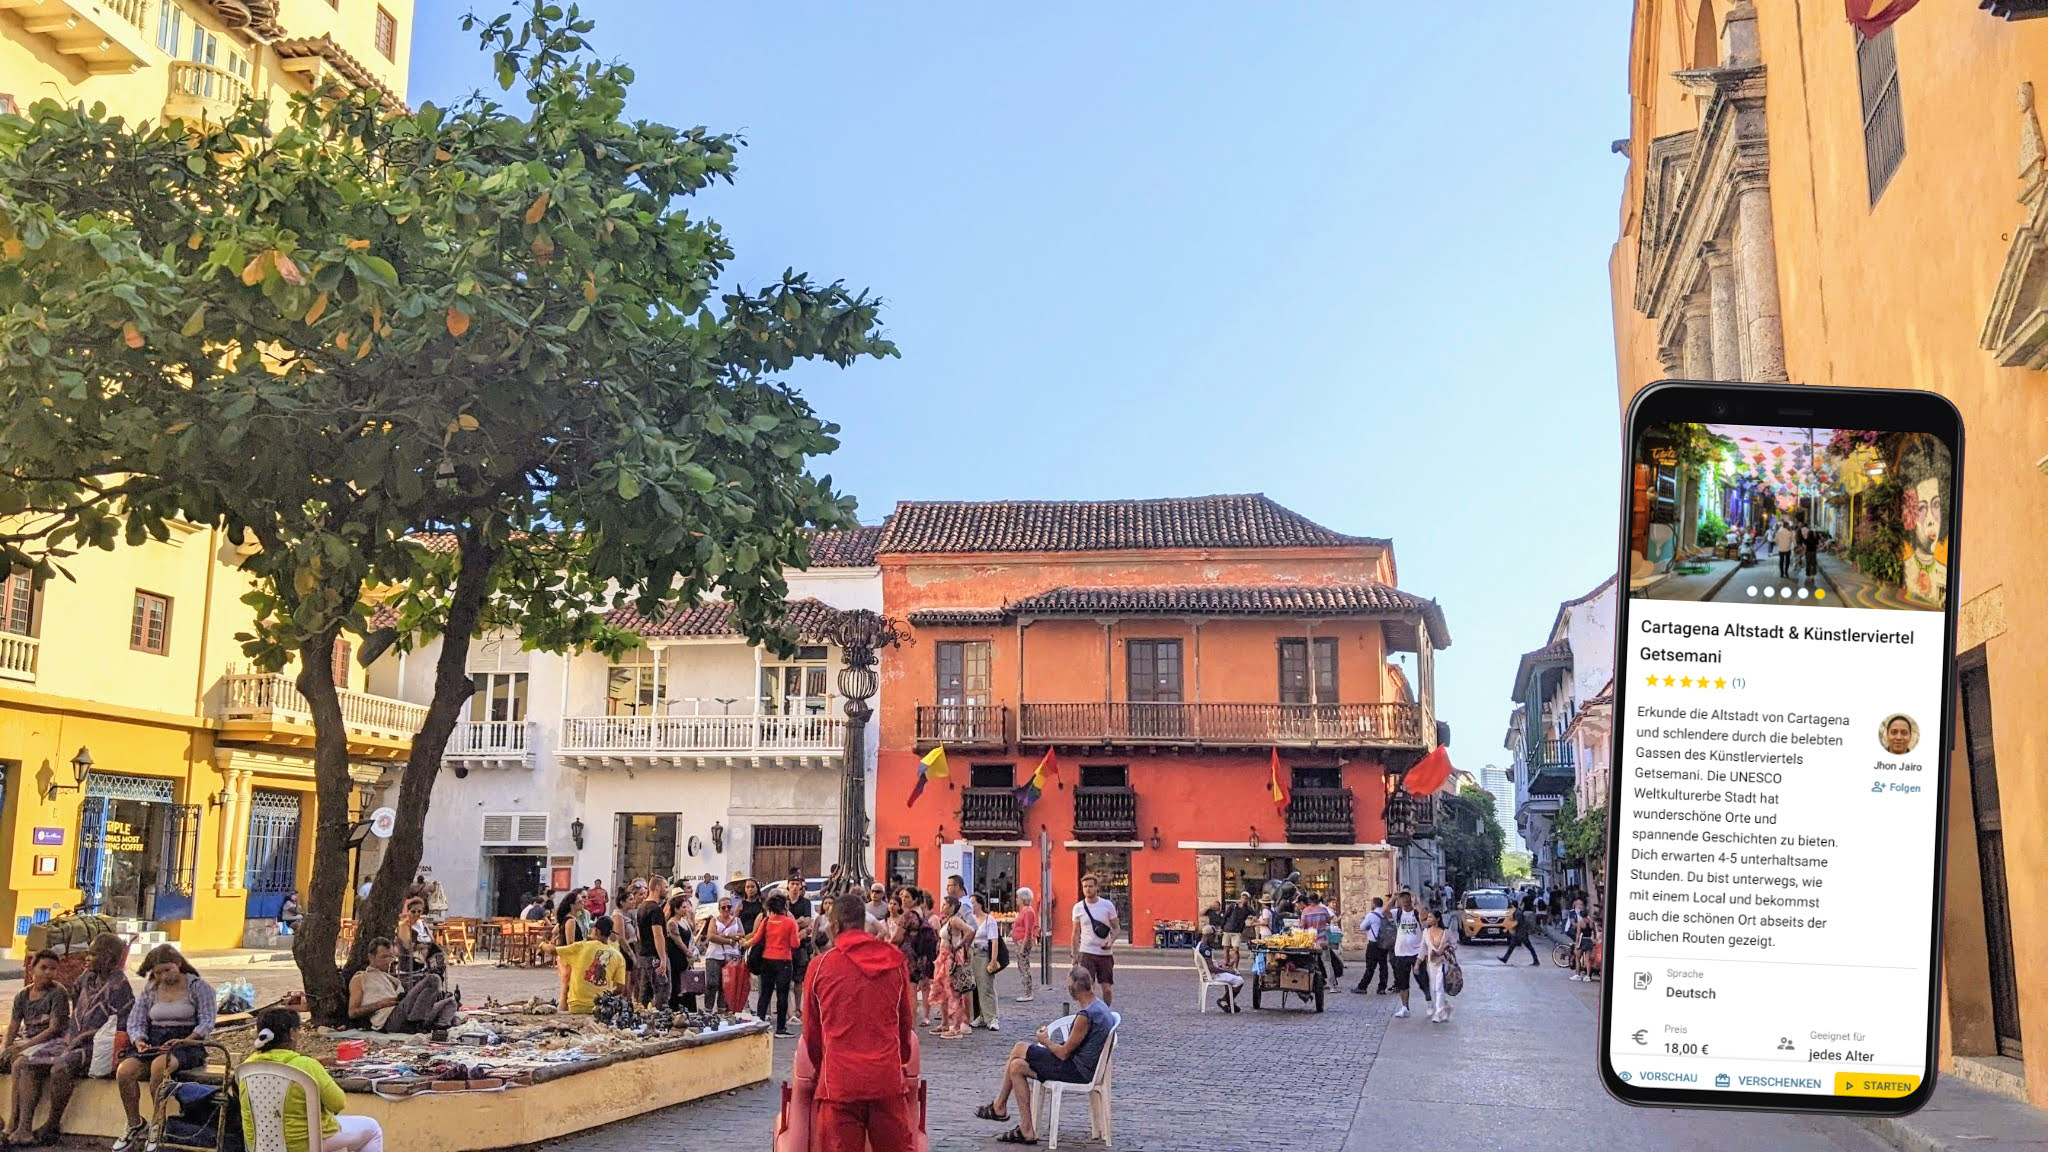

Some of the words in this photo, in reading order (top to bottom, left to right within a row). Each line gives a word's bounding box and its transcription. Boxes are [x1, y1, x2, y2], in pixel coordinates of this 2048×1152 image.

[1641, 619, 1719, 638] Cartagena
[1724, 623, 1784, 639] Altstadt
[1789, 626, 1800, 640] &
[1804, 626, 1914, 645] Künstlerviertel
[1640, 647, 1722, 664] Getsemani
[1732, 677, 1746, 689] (1)
[1637, 706, 1686, 719] Erkunde
[1690, 708, 1708, 720] die
[1711, 709, 1759, 722] Altstadt
[1762, 713, 1784, 723] von
[1787, 712, 1850, 727] Cartagena
[1636, 727, 1659, 739] und
[1662, 728, 1728, 741] schlendere
[1732, 730, 1766, 743] durch
[1769, 732, 1788, 744] die
[1791, 732, 1843, 746] belebten
[1635, 746, 1680, 760] Gassen
[1684, 748, 1706, 761] des
[1709, 749, 1803, 765] Künstlerviertels
[1873, 761, 1897, 772] Jhon
[1899, 762, 1922, 772] Jairo
[1634, 767, 1703, 781] Getsemani.
[1707, 770, 1726, 782] Die
[1730, 772, 1782, 785] UNESCO
[1634, 787, 1722, 802] Weltkulturerbe
[1725, 791, 1756, 804] Stadt
[1760, 792, 1779, 804] hat
[1889, 782, 1921, 794] Folgen
[1633, 808, 1722, 823] wunderschöne
[1725, 811, 1751, 824] Orte
[1754, 813, 1777, 825] und
[120, 843, 144, 851] COFFEE
[1632, 830, 1699, 844] spannende
[1702, 831, 1777, 845] Geschichten
[1780, 836, 1795, 846] zu
[1798, 835, 1838, 848] bieten.
[1631, 848, 1658, 861] Dich
[1661, 852, 1715, 863] erwarten
[1718, 852, 1738, 864] 4-5
[1740, 855, 1828, 868] unterhaltsame
[1630, 869, 1684, 882] Stunden.
[1687, 871, 1704, 883] Du
[1707, 871, 1729, 884] bist
[1732, 875, 1799, 888] unterwegs,
[1802, 876, 1823, 888] wie
[1629, 889, 1649, 901] mit
[1652, 890, 1690, 903] einem
[1693, 891, 1726, 904] Local
[1729, 894, 1752, 905] und
[1755, 894, 1820, 908] bekommst
[1628, 910, 1658, 922] auch
[1662, 911, 1680, 923] die
[1683, 912, 1734, 925] schönen
[1738, 914, 1757, 926] Ort
[1760, 915, 1805, 928] abseits
[1807, 917, 1827, 929] der
[1628, 929, 1679, 943] üblichen
[1682, 931, 1725, 945] Routen
[1728, 935, 1776, 949] gezeigt.
[1666, 969, 1704, 980] Sprache
[1666, 987, 1716, 1000] Deutsch
[1664, 1024, 1688, 1034] Preis
[1809, 1031, 1851, 1042] Geeignet
[1853, 1032, 1866, 1042] für
[1664, 1042, 1698, 1056] 18,00
[1701, 1044, 1709, 1055] €
[1808, 1048, 1842, 1062] jedes
[1845, 1050, 1874, 1062] Alter
[1639, 1071, 1698, 1083] VORSCHAU
[1738, 1075, 1822, 1089] VERSCHENKEN
[1863, 1080, 1912, 1093] STARTEN
